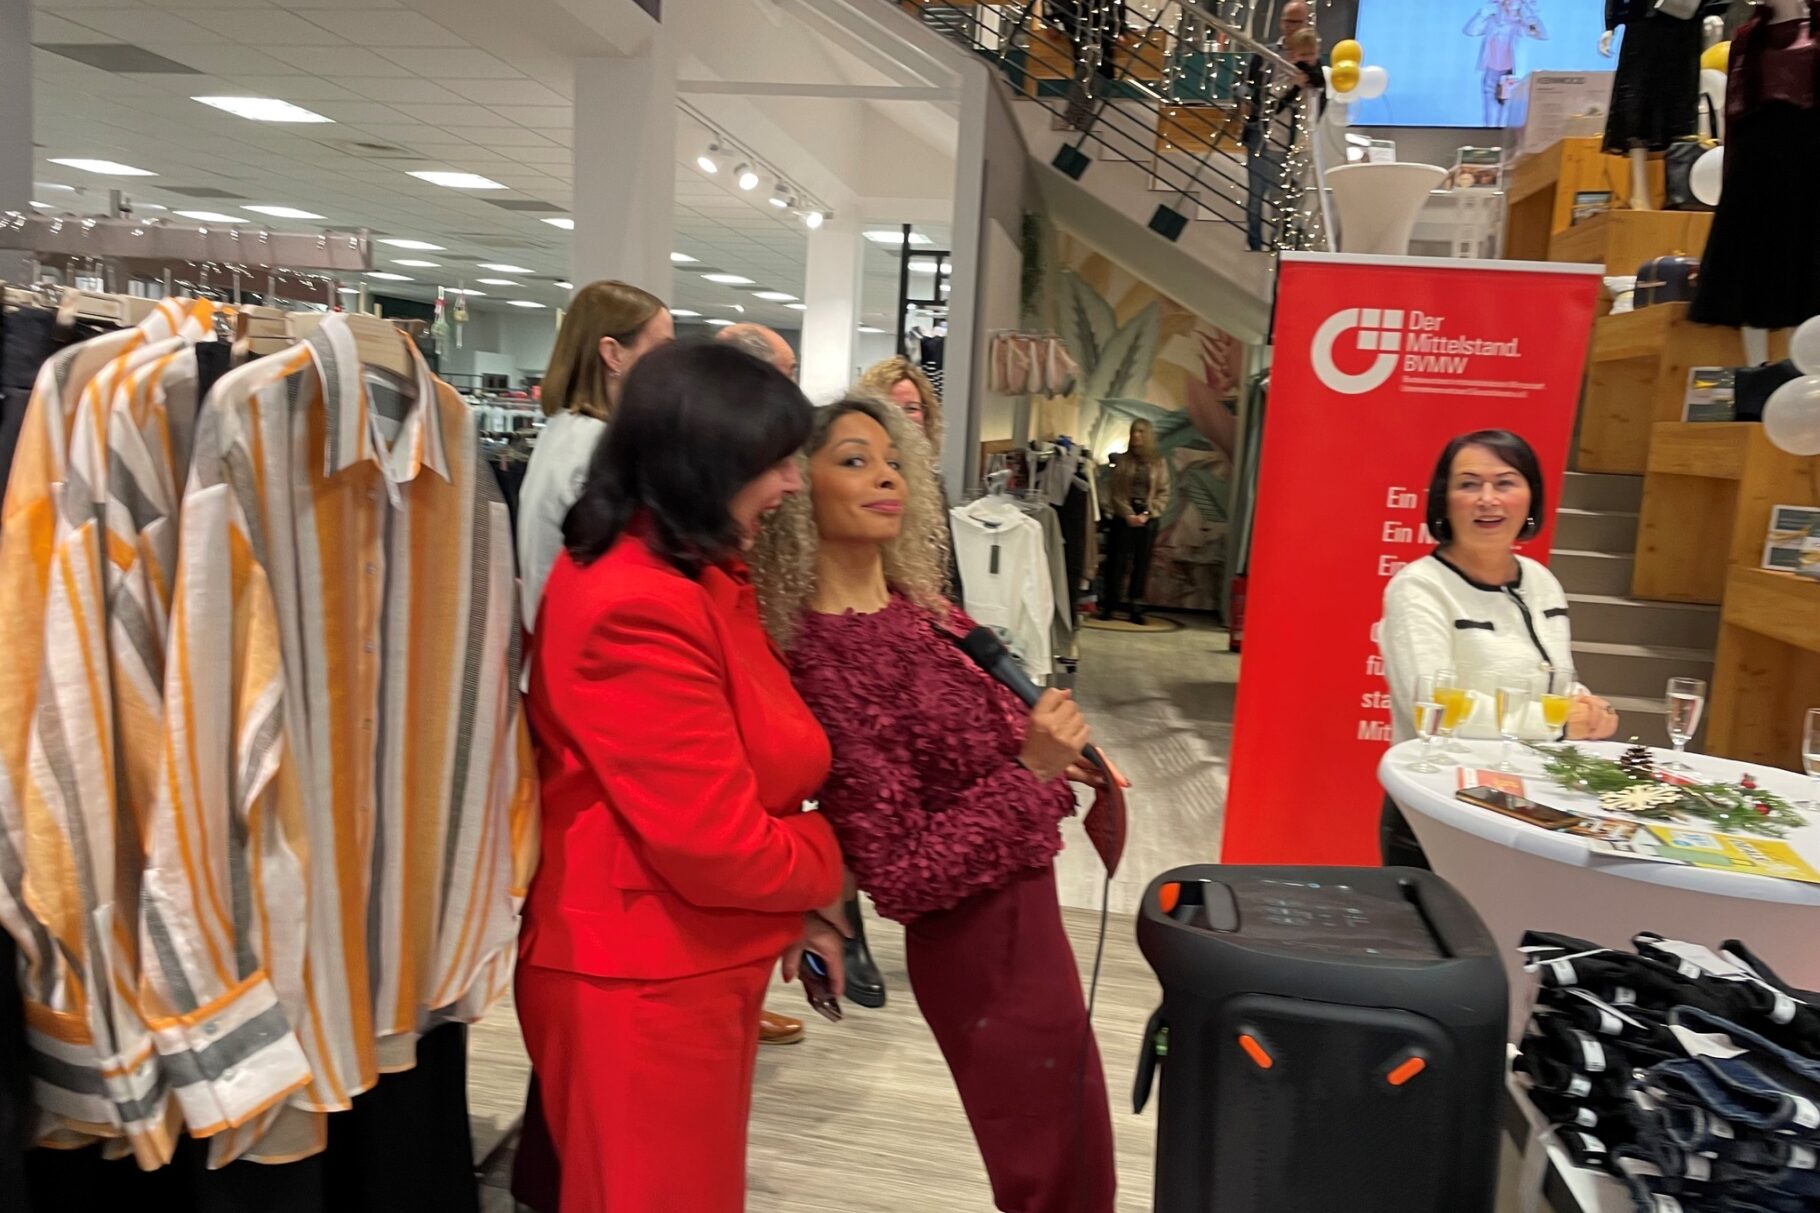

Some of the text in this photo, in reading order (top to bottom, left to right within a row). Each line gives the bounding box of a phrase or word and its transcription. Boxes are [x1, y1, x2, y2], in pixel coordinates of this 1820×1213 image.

[1409, 310, 1445, 331] Der
[1403, 354, 1468, 374] BVMW
[1386, 486, 1418, 509] Ein
[1382, 520, 1412, 543] Ein
